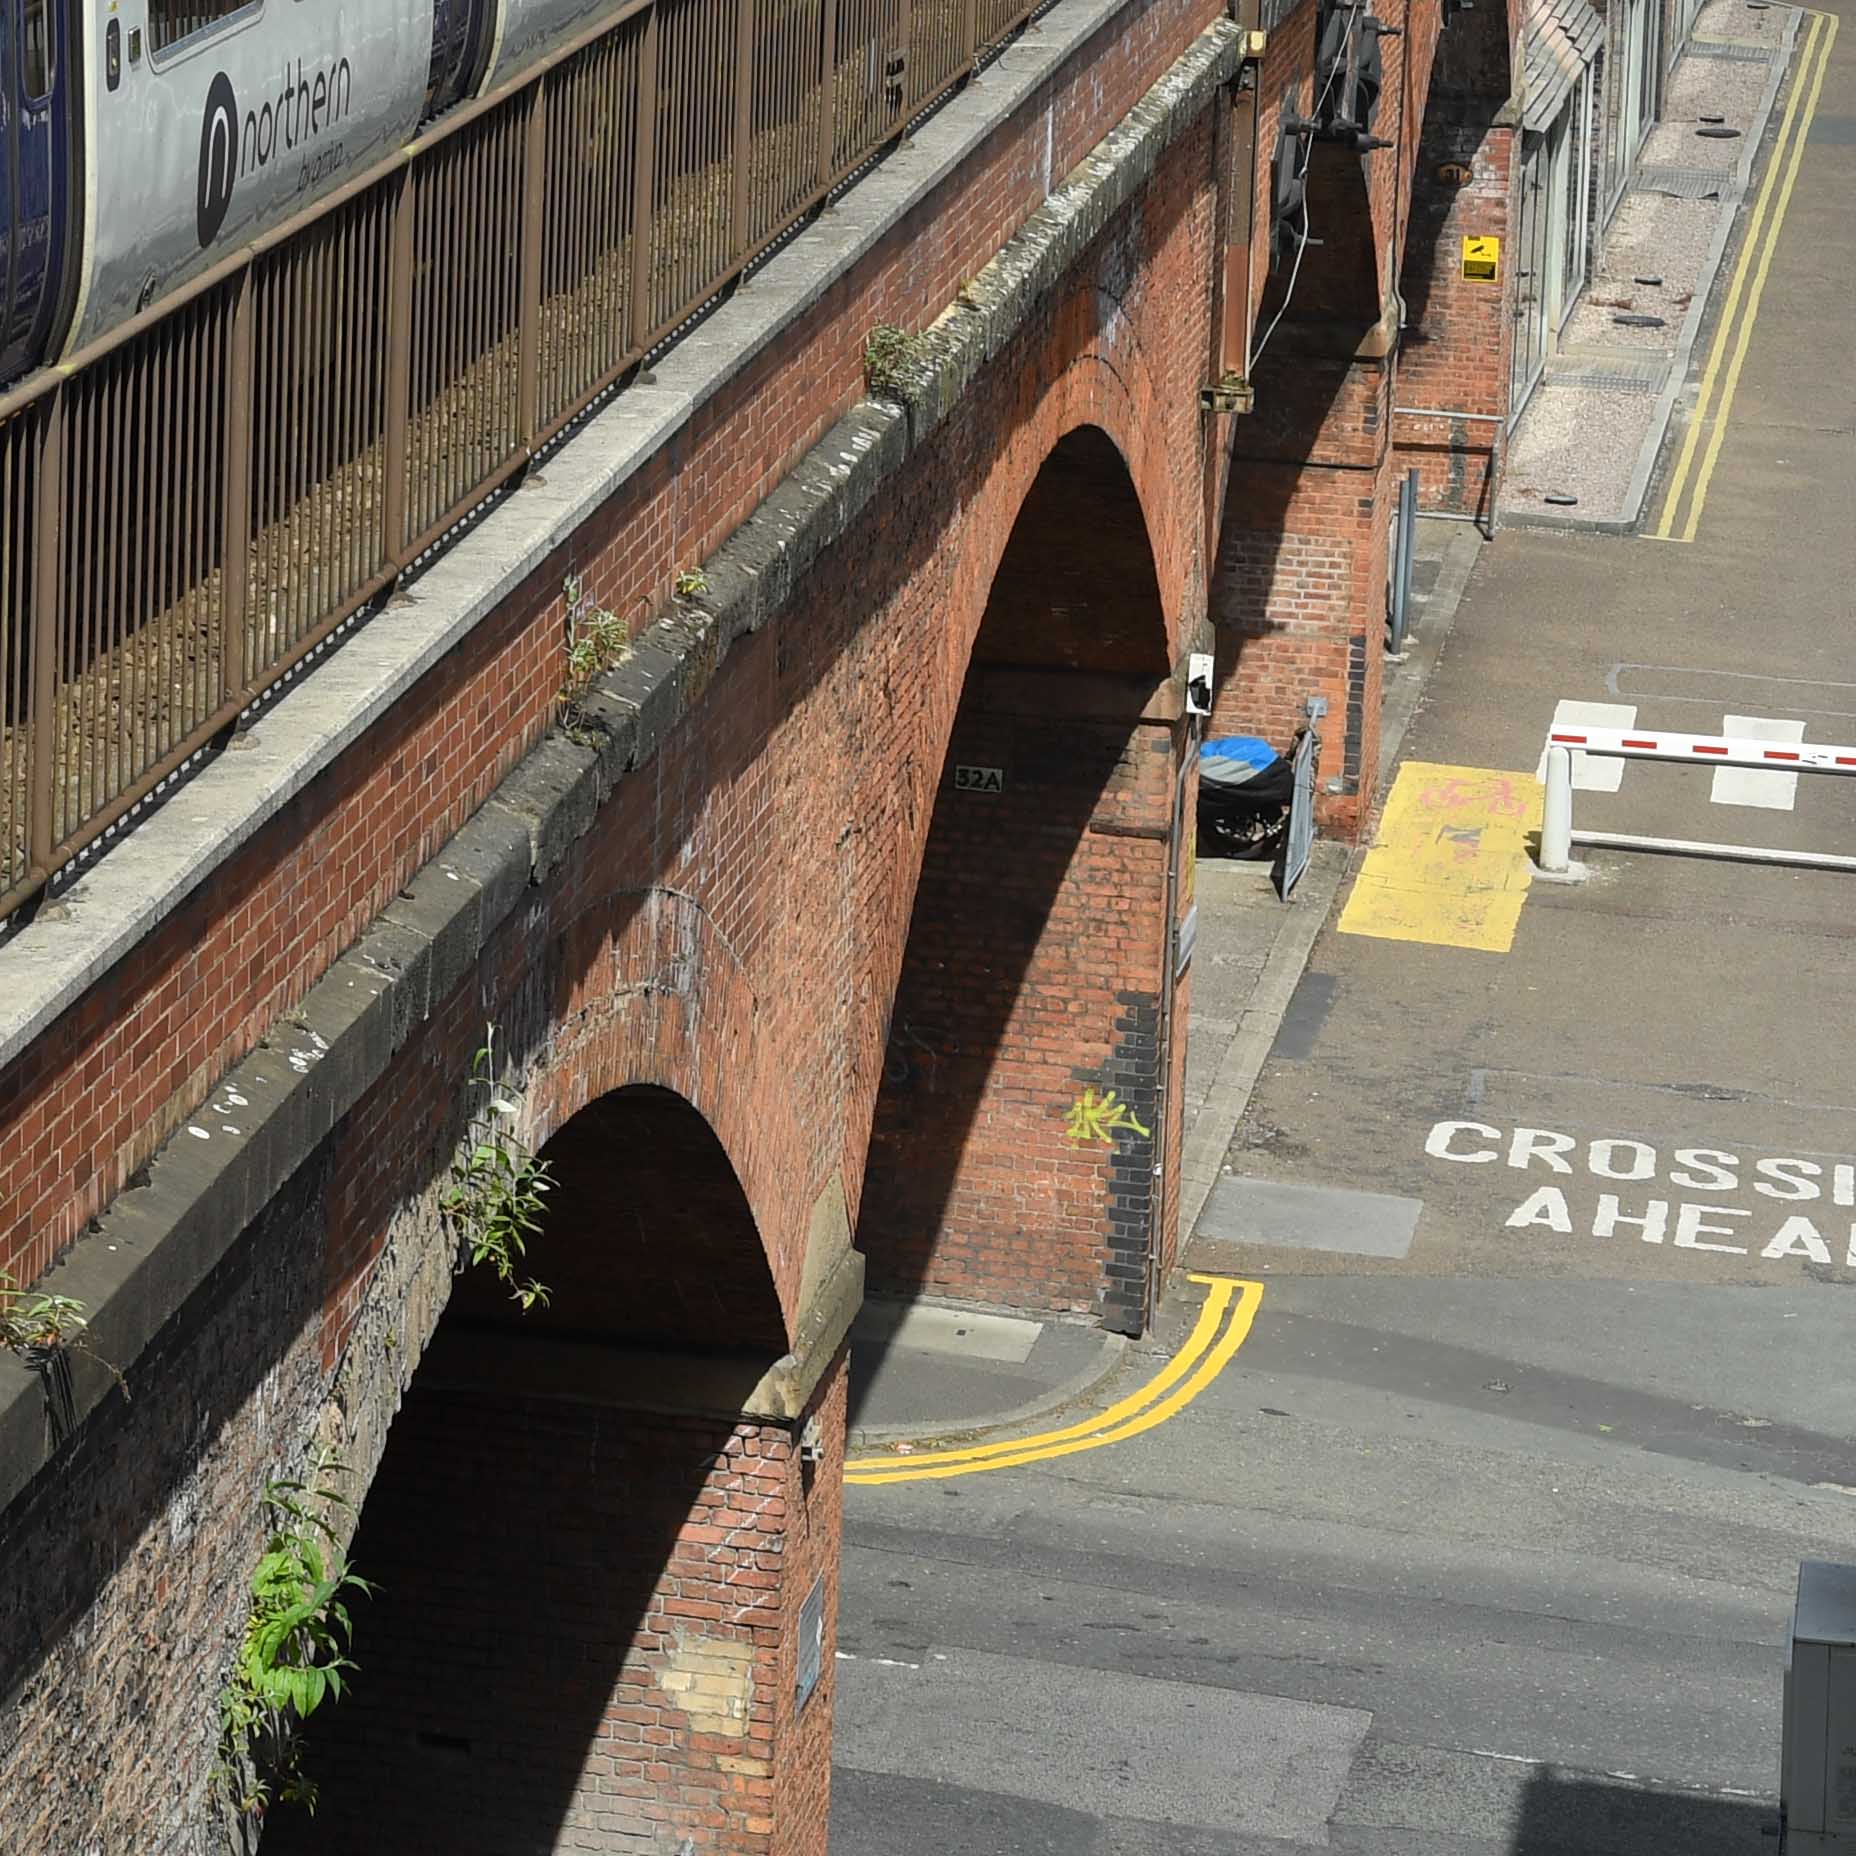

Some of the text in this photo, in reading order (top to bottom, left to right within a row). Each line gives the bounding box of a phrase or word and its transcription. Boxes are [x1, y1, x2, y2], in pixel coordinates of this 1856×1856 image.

[240, 56, 351, 178] northern
[1425, 1120, 1855, 1207] CROSSI
[1504, 1186, 1856, 1267] AHEA
